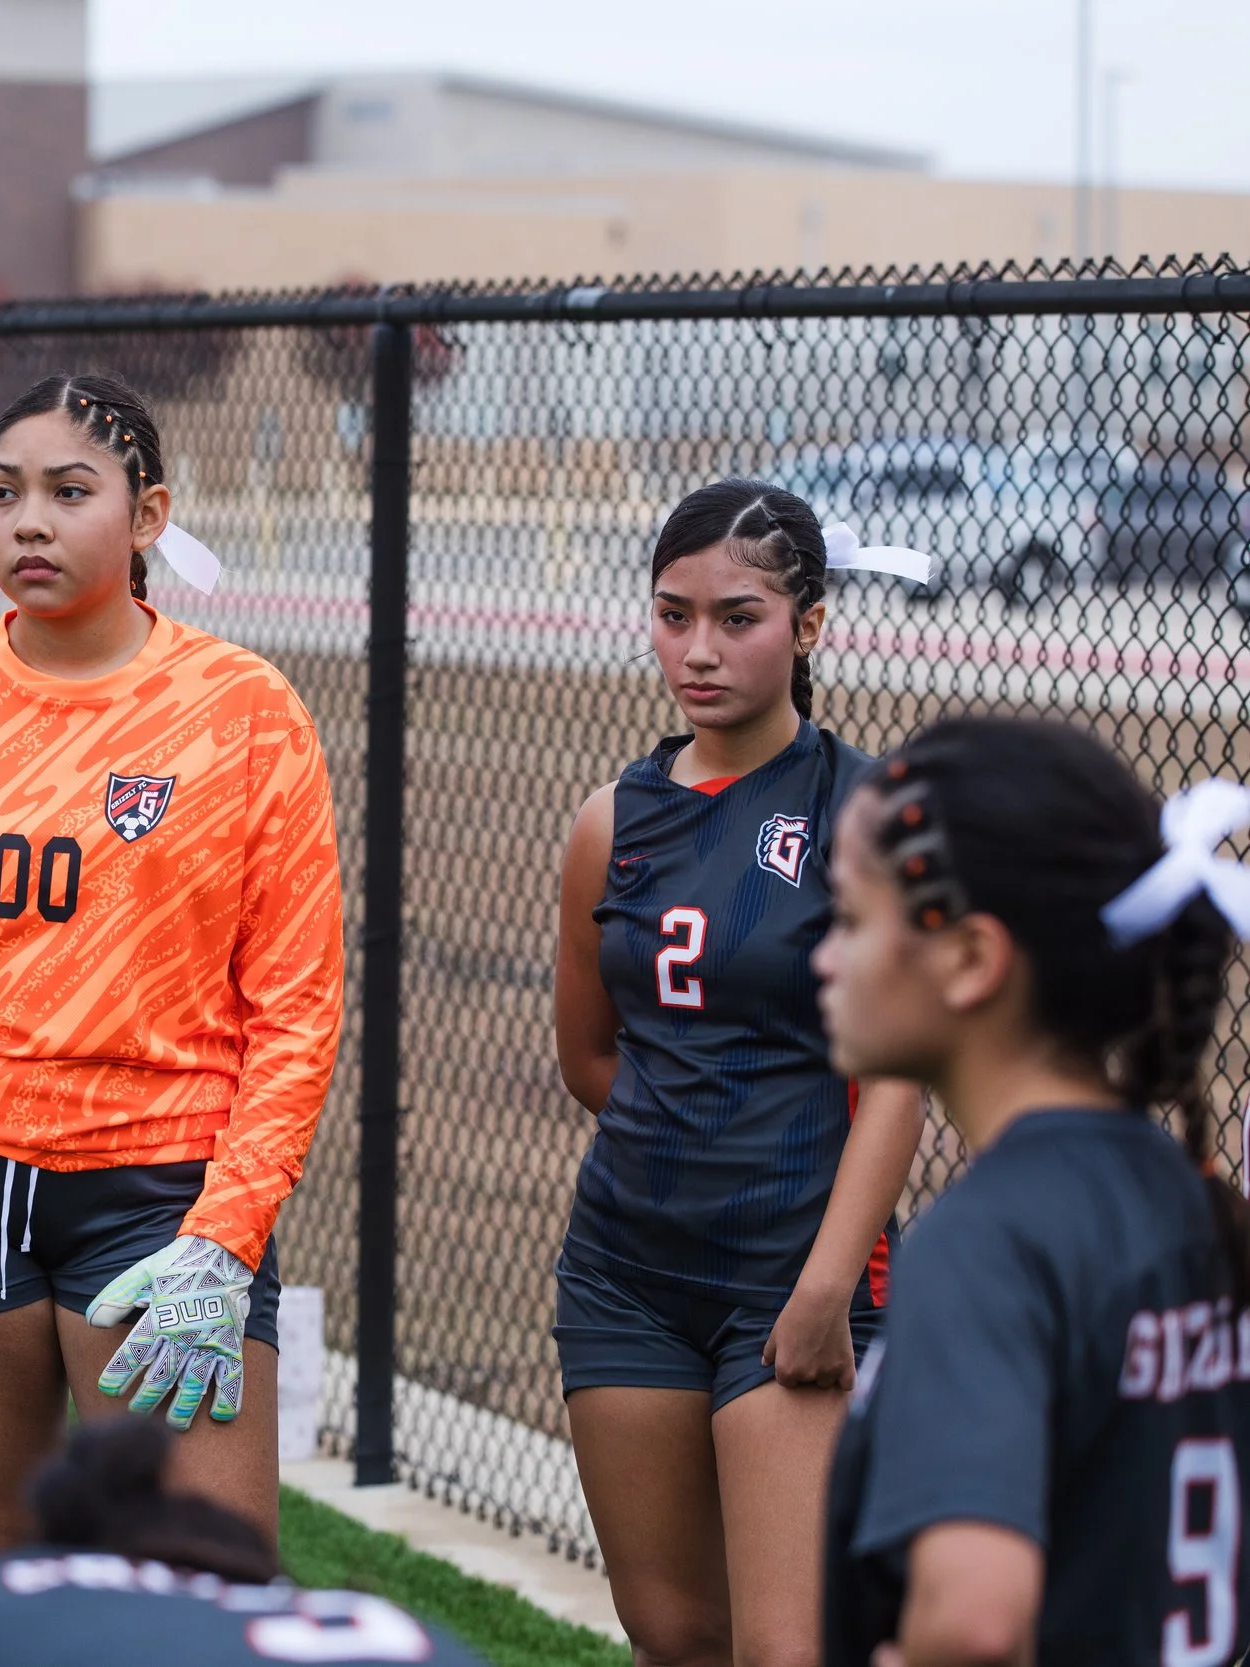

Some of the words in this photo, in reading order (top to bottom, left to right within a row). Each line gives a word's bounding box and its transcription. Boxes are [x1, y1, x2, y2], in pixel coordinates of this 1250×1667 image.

[111, 788, 136, 810] GRIZZLY
[138, 781, 147, 790] FC
[138, 790, 159, 819] G
[766, 816, 808, 882] G
[655, 906, 709, 1009] 2
[1161, 1436, 1241, 1667] 9
